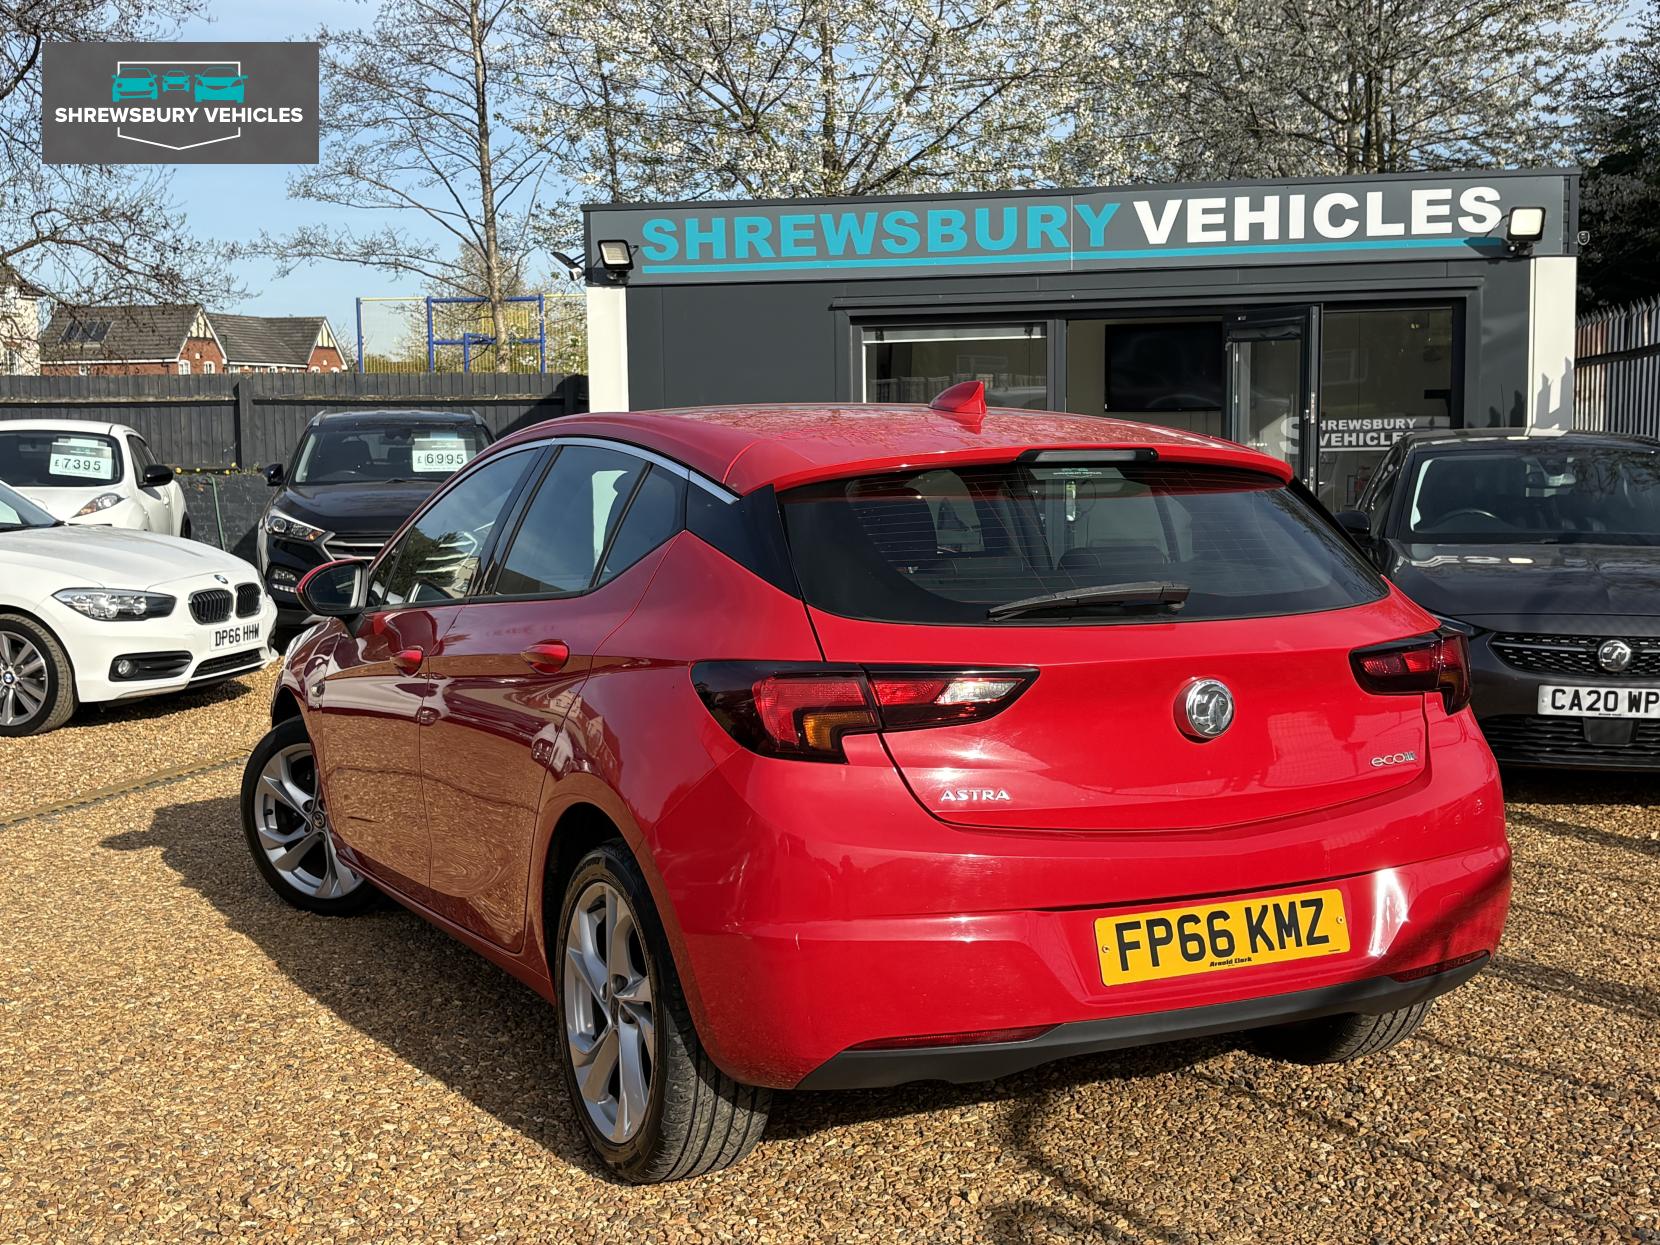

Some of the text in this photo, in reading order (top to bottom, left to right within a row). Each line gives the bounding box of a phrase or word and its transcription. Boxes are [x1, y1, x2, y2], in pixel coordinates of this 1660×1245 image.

[642, 186, 1501, 261] SHREWSBURY VEHICLES
[1319, 432, 1415, 446] VEHICLE
[215, 627, 241, 647] DP66
[1551, 688, 1660, 713] CA20 WP
[940, 789, 1011, 802] ASTRA
[1115, 897, 1330, 972] FP66 KMZ
